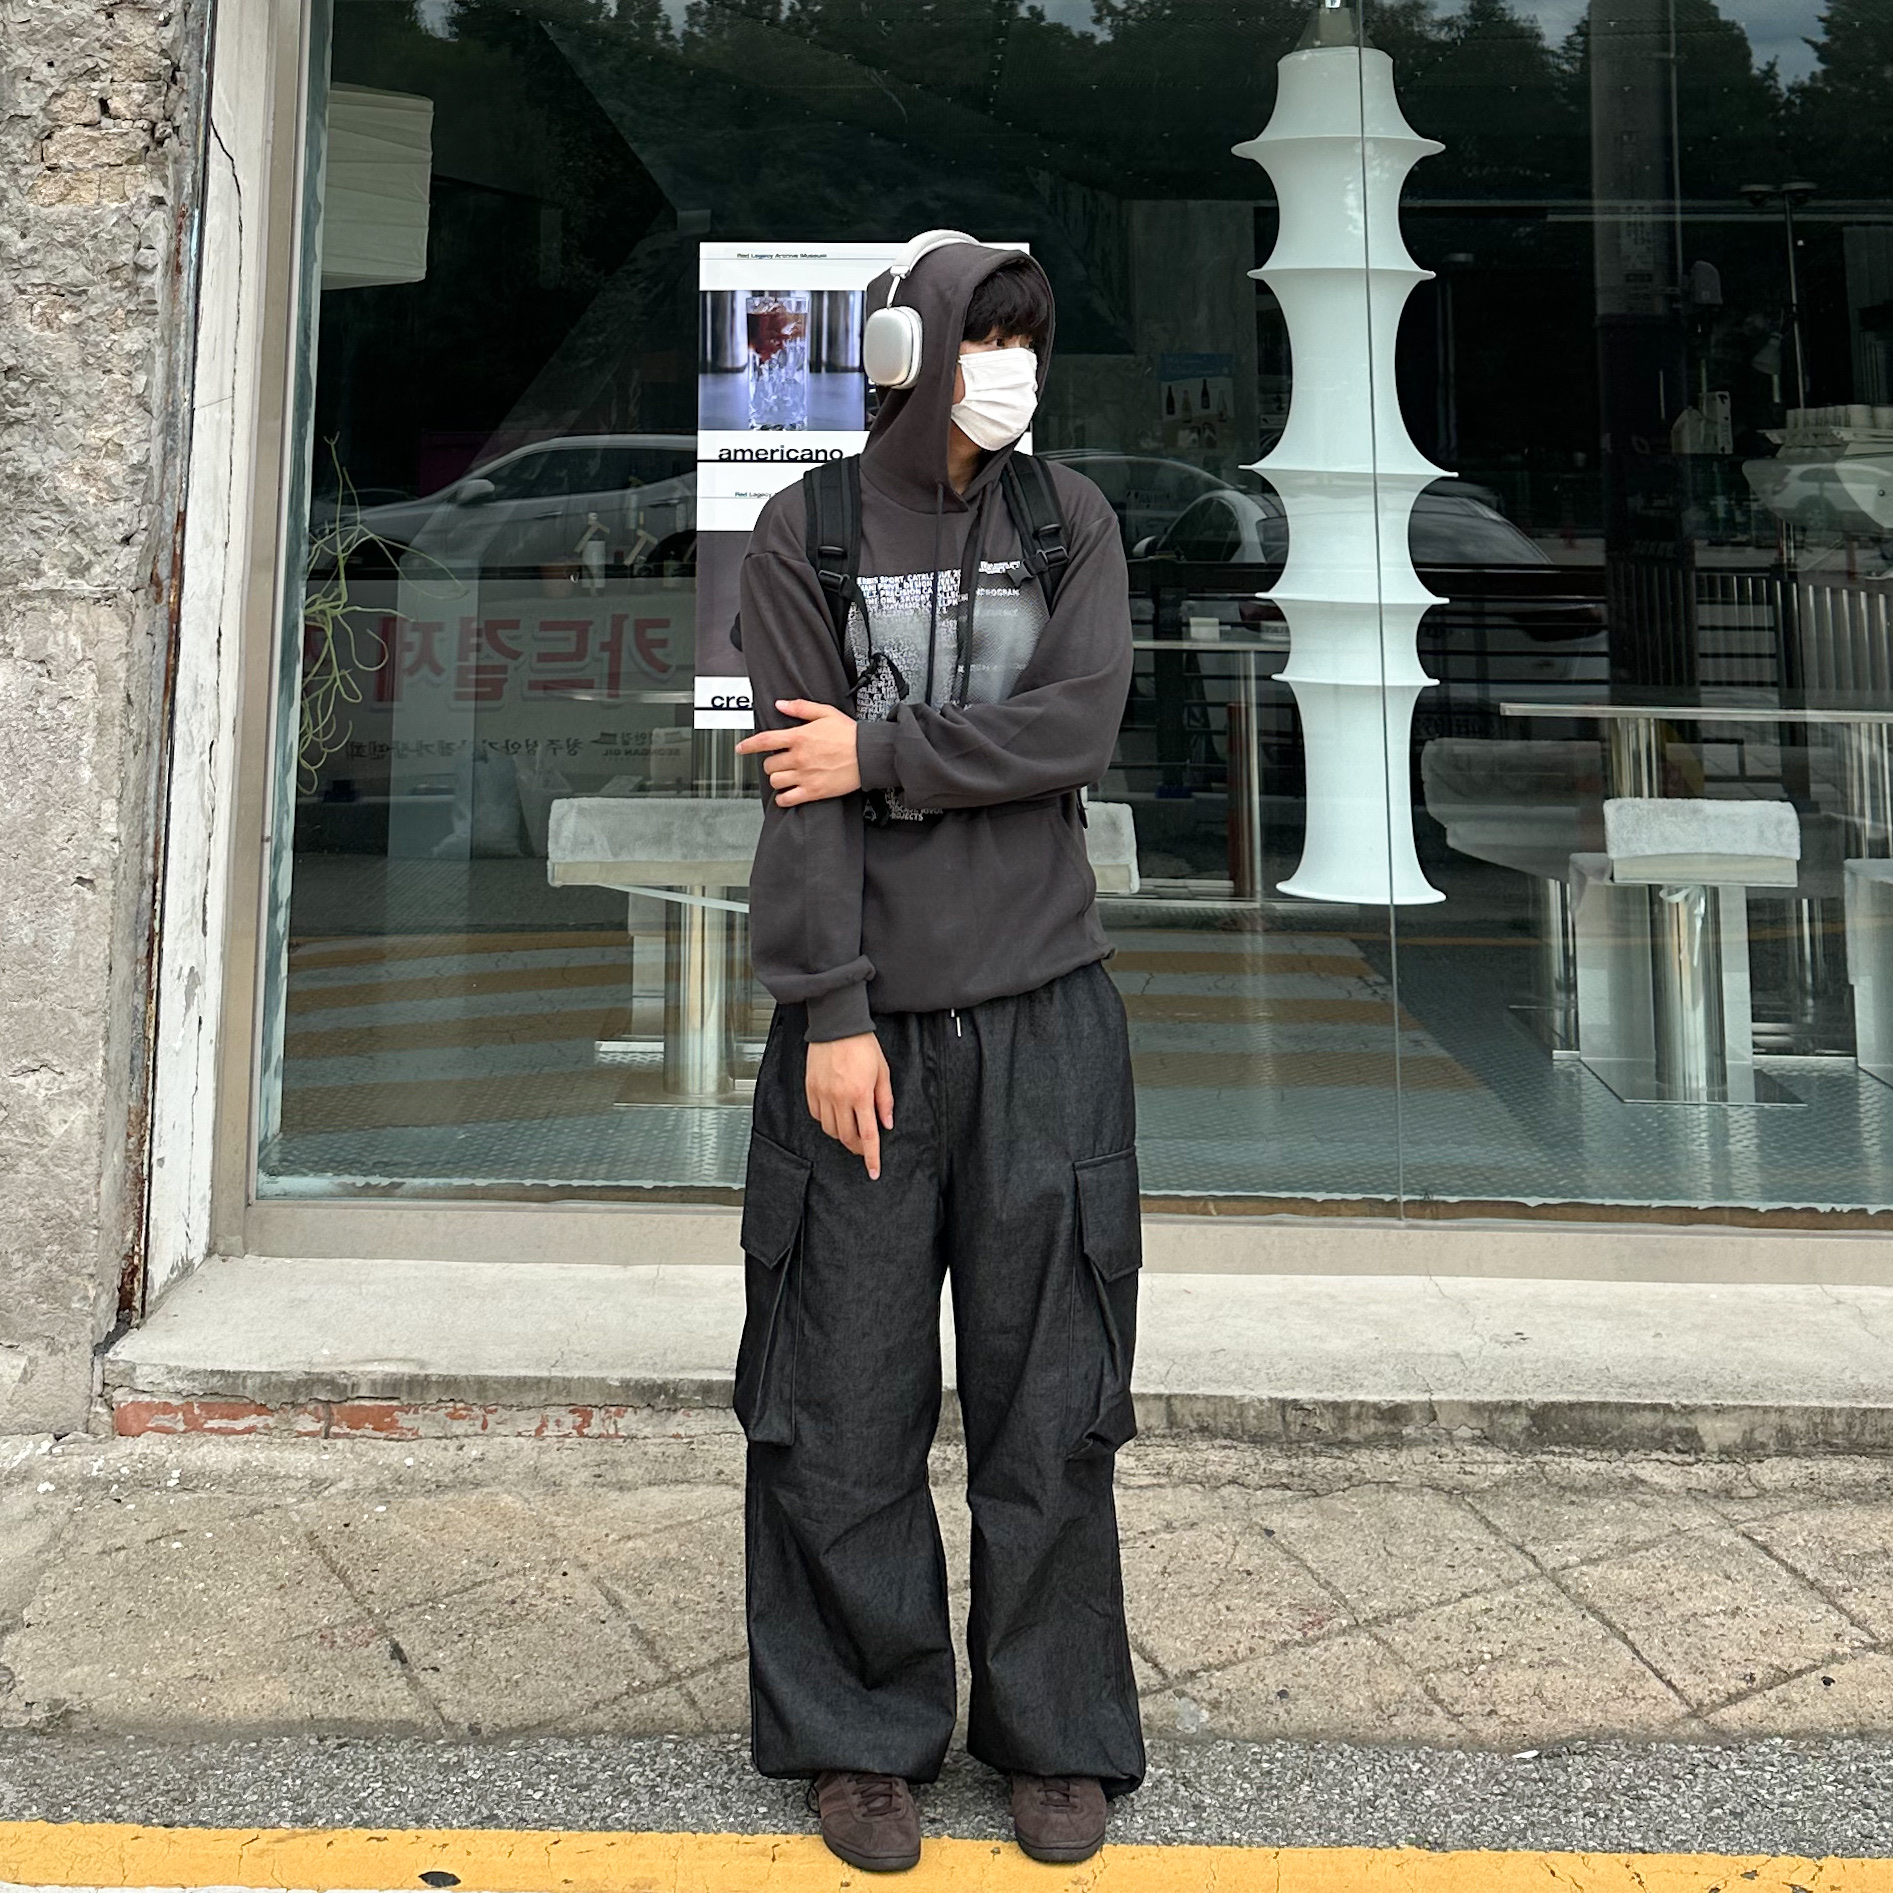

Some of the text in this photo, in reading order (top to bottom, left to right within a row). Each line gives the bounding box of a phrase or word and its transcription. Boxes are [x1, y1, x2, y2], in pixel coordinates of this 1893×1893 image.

[751, 252, 774, 260] Legacy
[718, 444, 844, 461] americano
[749, 491, 773, 499] Legacy
[710, 693, 753, 709] cre
